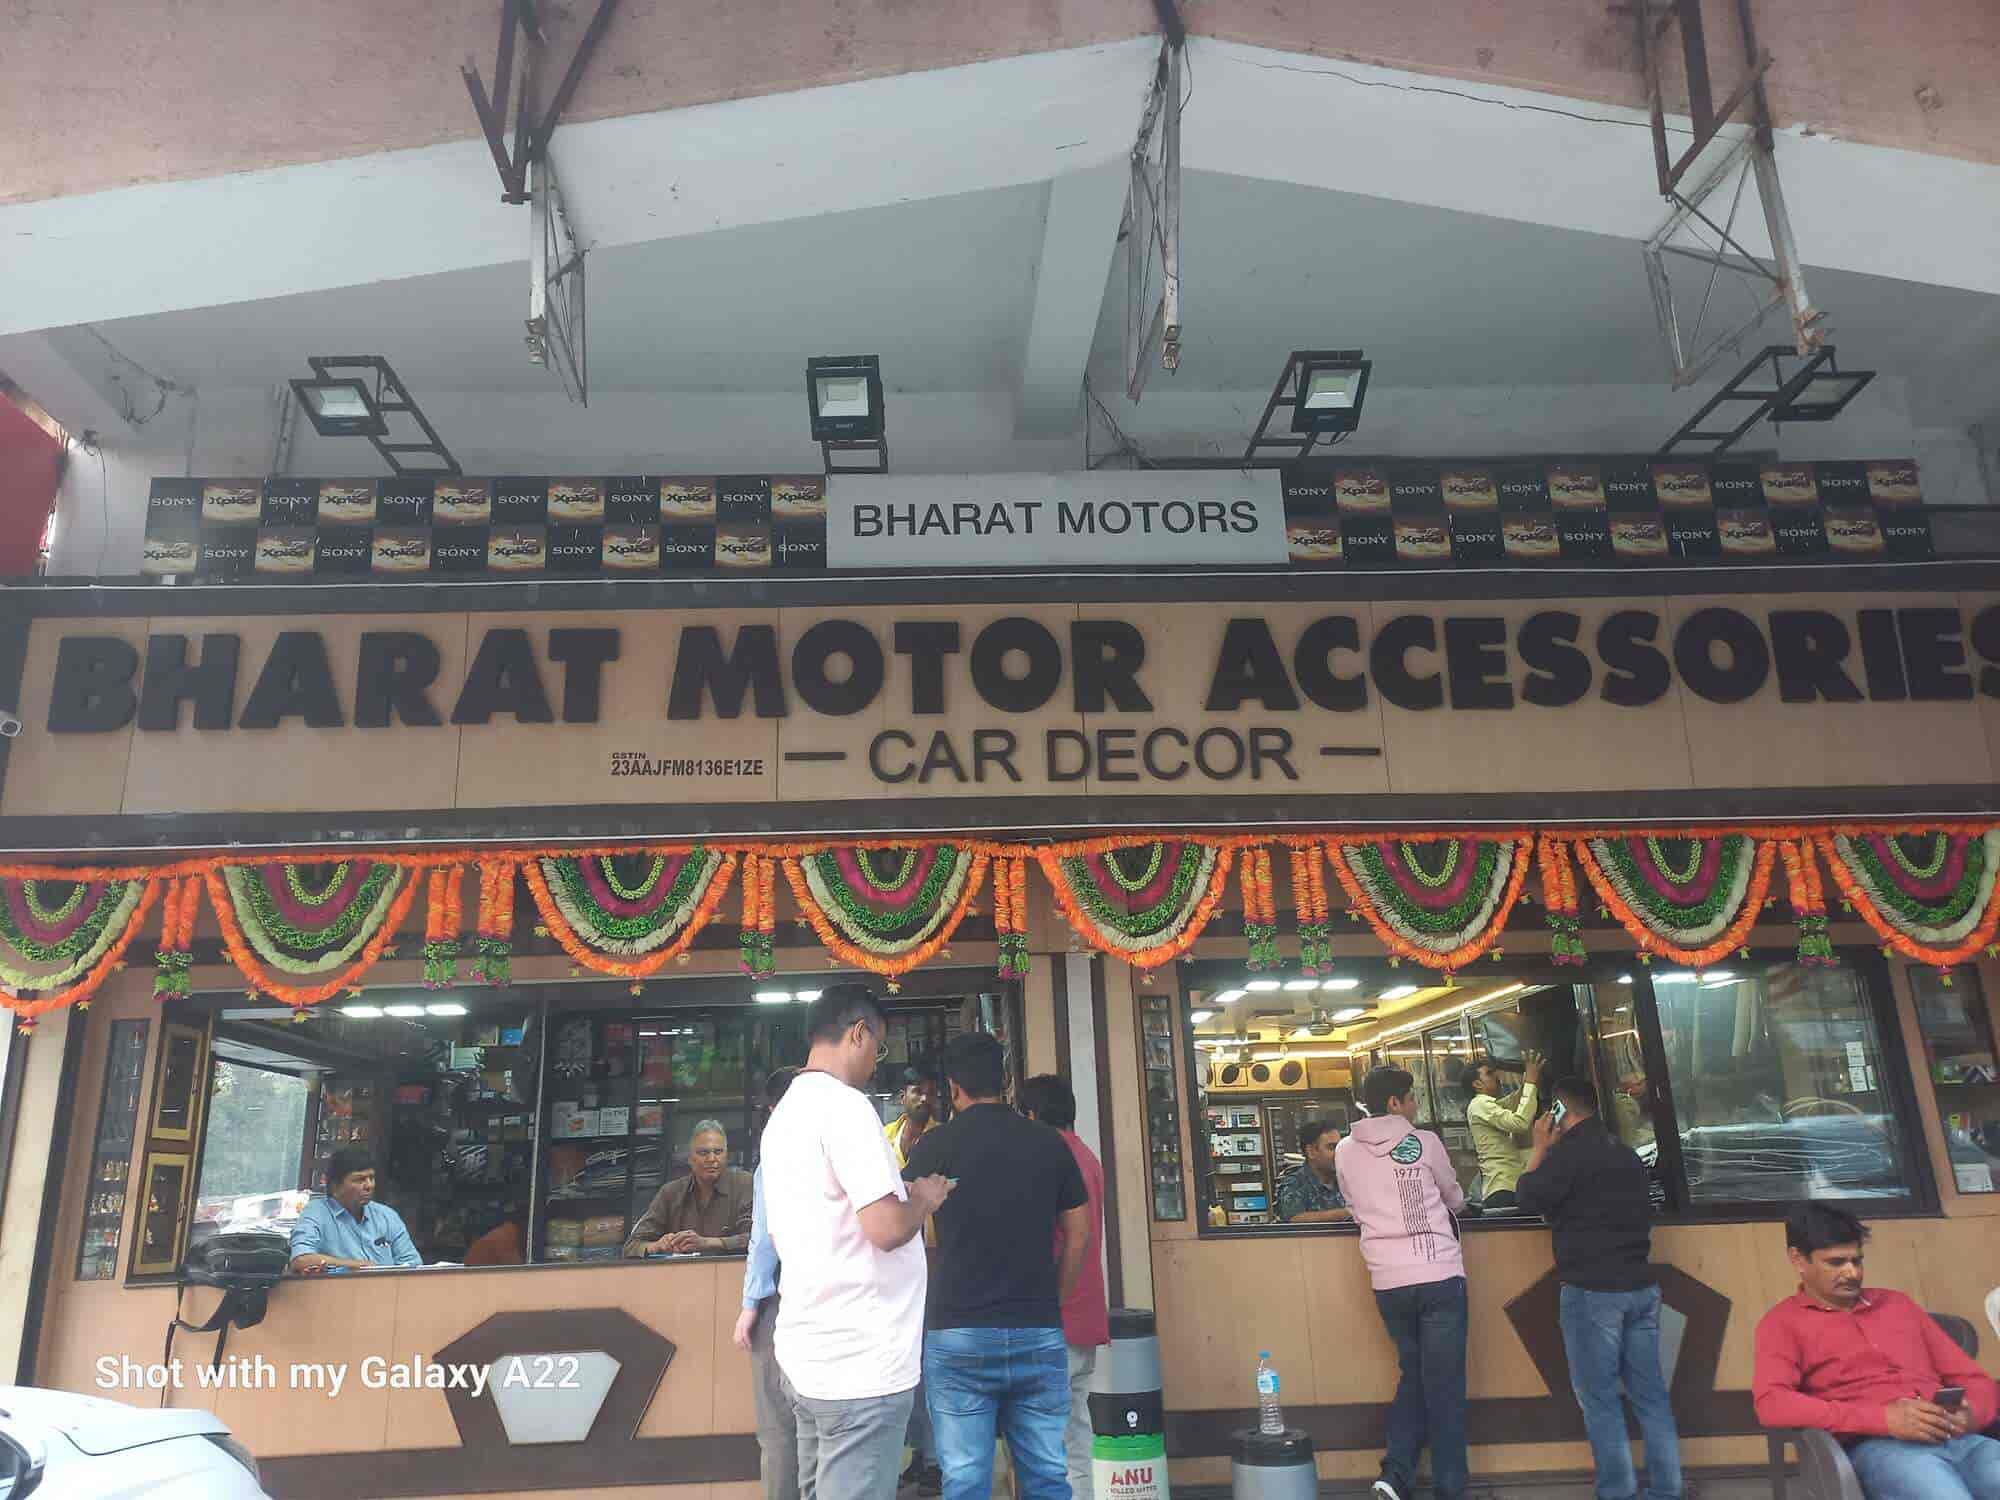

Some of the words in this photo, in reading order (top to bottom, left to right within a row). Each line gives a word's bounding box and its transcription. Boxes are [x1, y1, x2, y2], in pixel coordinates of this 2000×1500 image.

[1288, 487, 1328, 496] SONY
[1395, 486, 1436, 495] SONY
[1502, 484, 1541, 493] SONY
[1608, 482, 1648, 491] SONY
[1715, 480, 1755, 489] SONY
[1822, 479, 1860, 488] SONY
[152, 497, 196, 505] SONY
[269, 496, 312, 505] SONY
[384, 496, 425, 505] SONY
[498, 495, 540, 504] SONY
[612, 494, 654, 503] SONY
[723, 494, 765, 502] SONY
[853, 502, 1042, 537] BHARAT
[1058, 500, 1258, 534] MOTORS
[1348, 536, 1388, 545] SONY
[1456, 534, 1496, 543] SONY
[1564, 532, 1604, 541] SONY
[1672, 531, 1712, 540] SONY
[1779, 528, 1819, 537] SONY
[1886, 527, 1926, 536] SONY
[204, 549, 248, 559] SONY
[321, 548, 364, 557] SONY
[437, 548, 481, 557] SONY
[552, 546, 595, 555] SONY
[666, 544, 709, 553] SONY
[778, 544, 819, 552] SONY
[47, 627, 620, 733] BHARAT
[667, 617, 1154, 721] MOTOR
[868, 729, 1022, 784] CAR
[1046, 726, 1299, 782] DECOR
[611, 759, 763, 776] 23AAJFM8136E1ZE
[1394, 1168, 1420, 1178] 1977
[1111, 1467, 1152, 1485] ANU
